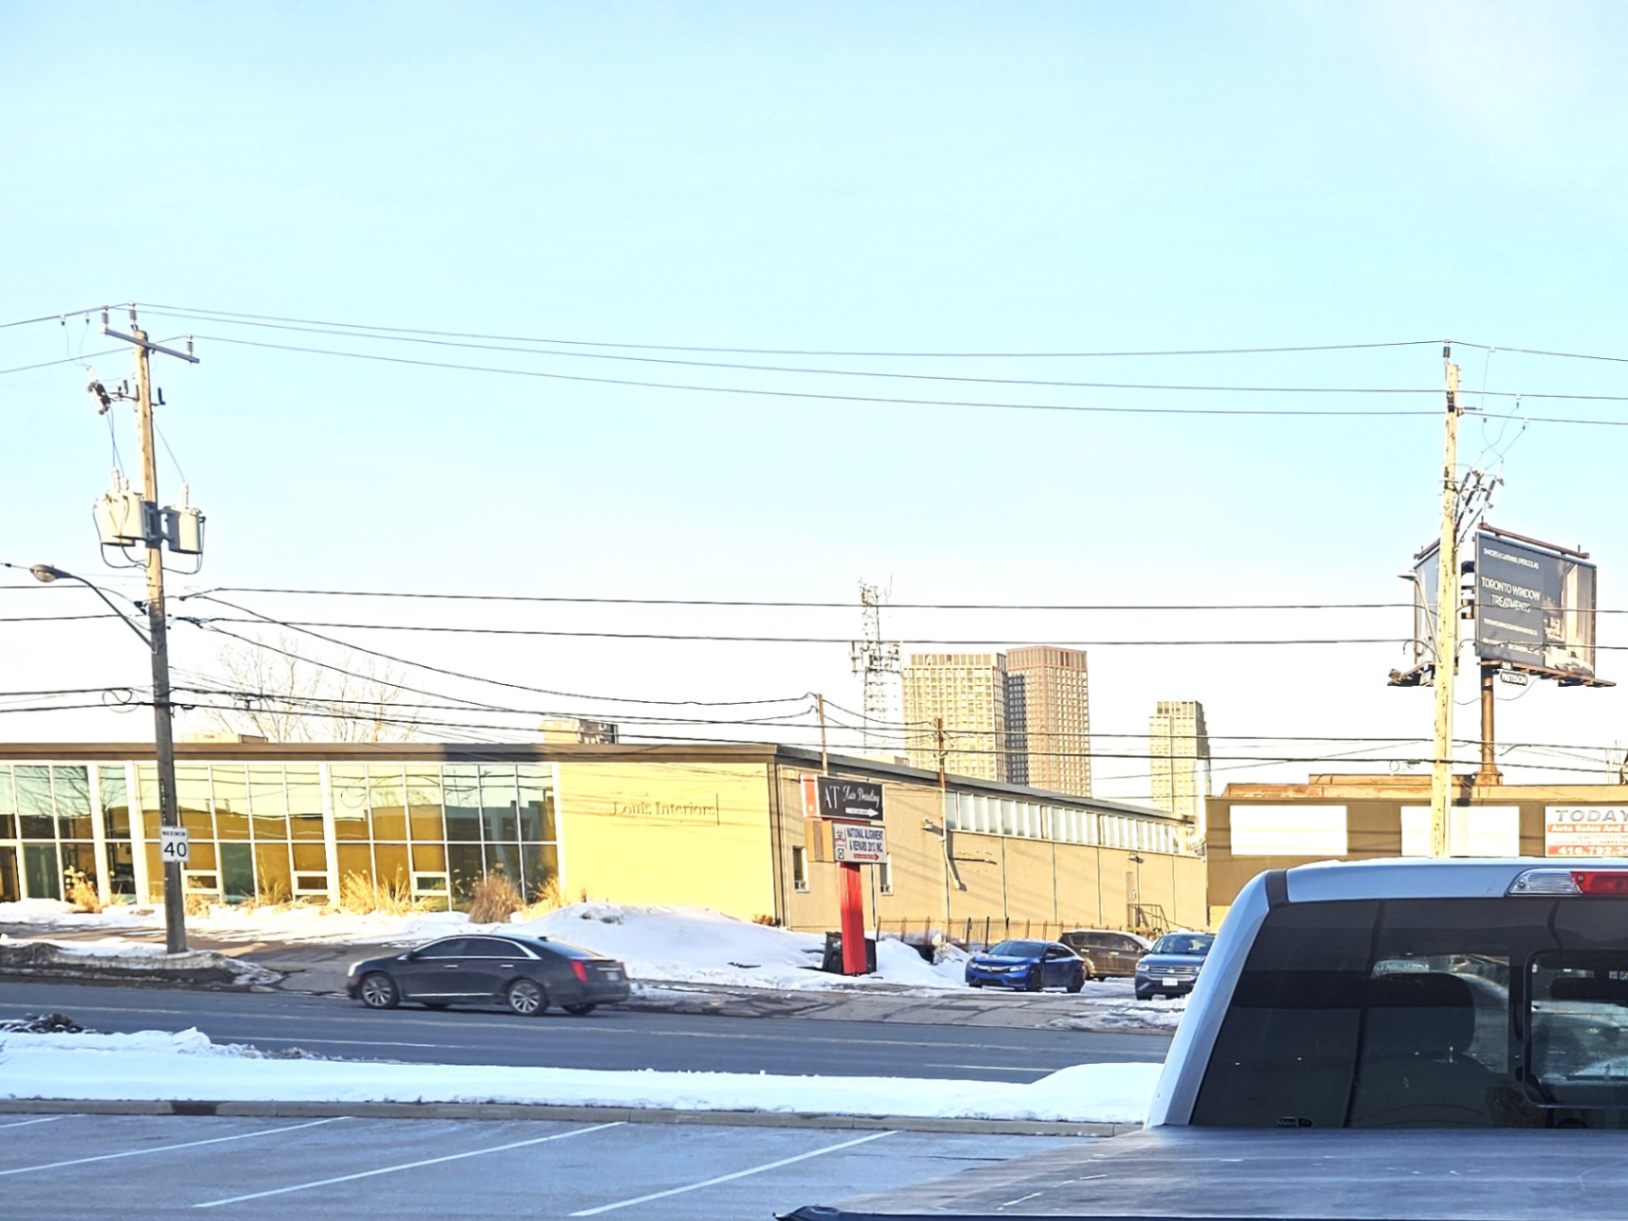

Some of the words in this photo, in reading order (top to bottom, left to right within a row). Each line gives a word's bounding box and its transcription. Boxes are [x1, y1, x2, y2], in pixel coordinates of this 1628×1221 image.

[1481, 576, 1511, 594] TORONTO
[1512, 585, 1541, 601] WINDOW
[1491, 594, 1531, 613] TREATMENTS
[613, 801, 652, 816] Louis
[656, 801, 716, 816] Interiors
[1551, 824, 1573, 832] Auto
[1603, 824, 1621, 832] And
[164, 842, 187, 857] 40
